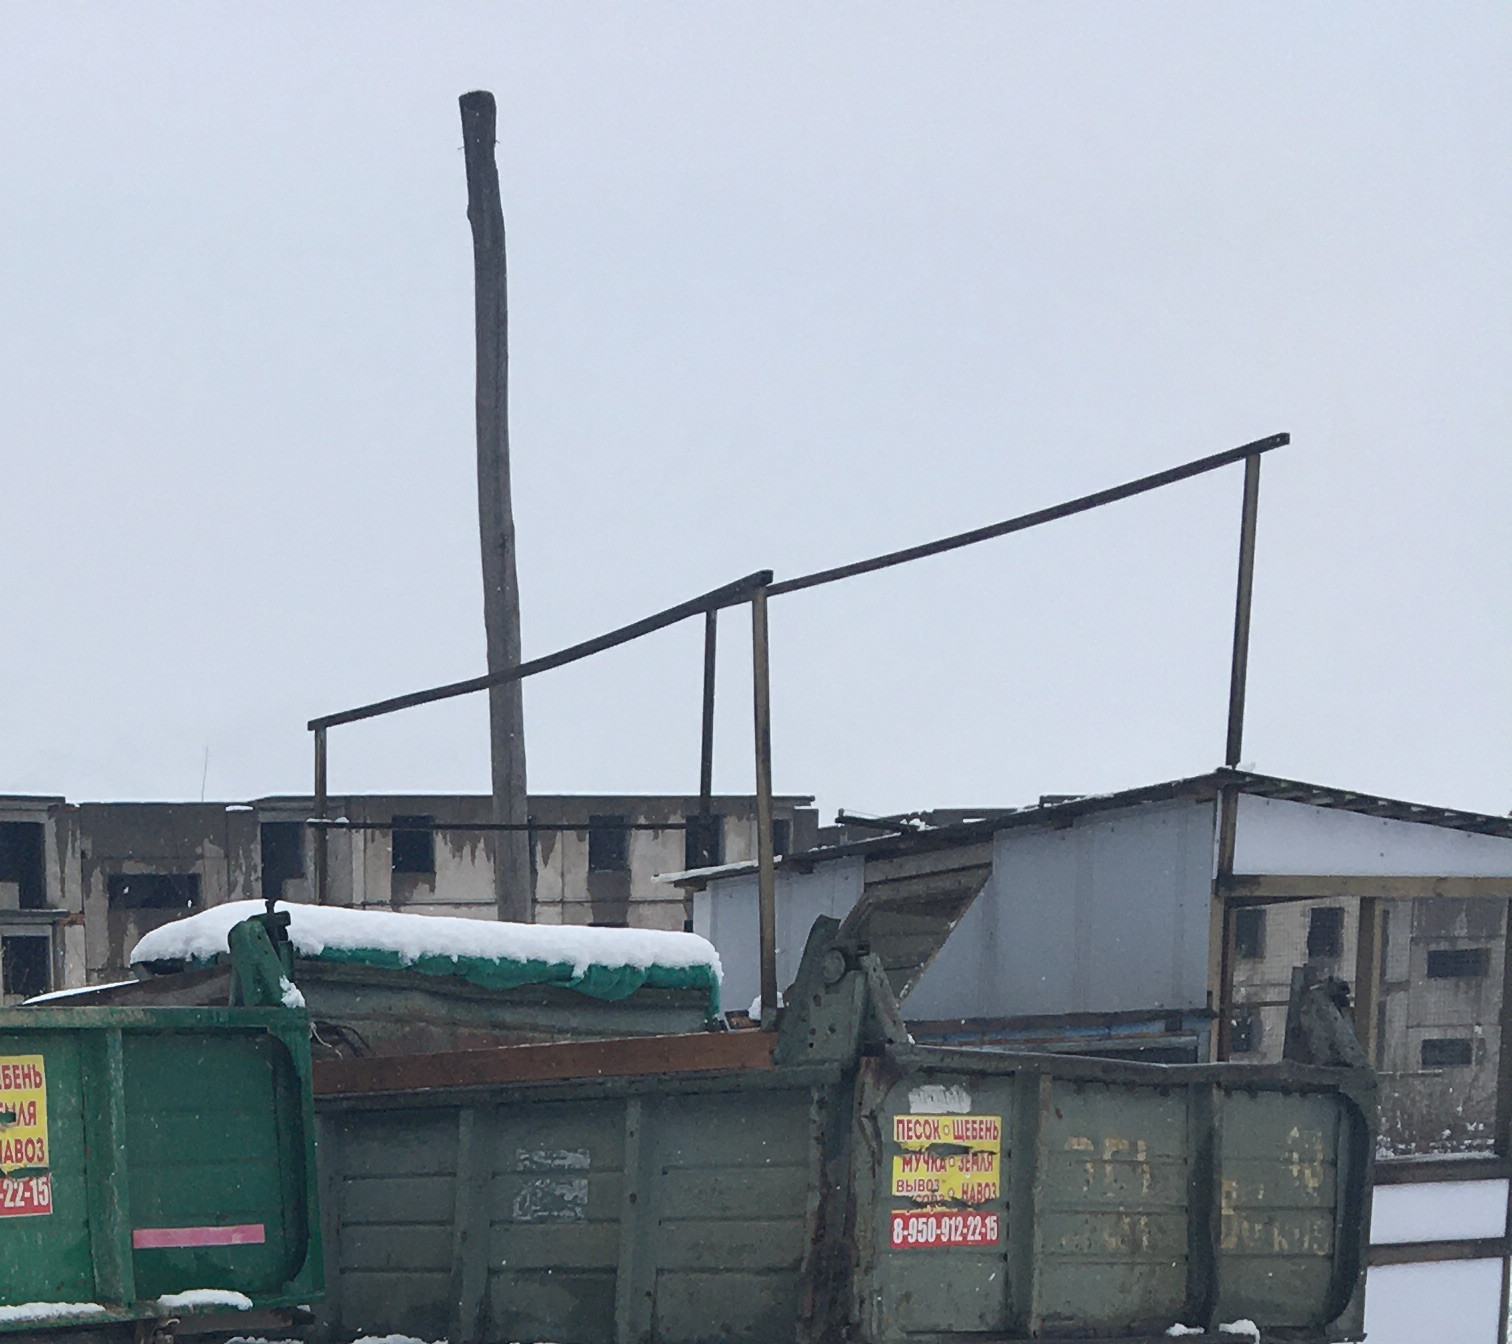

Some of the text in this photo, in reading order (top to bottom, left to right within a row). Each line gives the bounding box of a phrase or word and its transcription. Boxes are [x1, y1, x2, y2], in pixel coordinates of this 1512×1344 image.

[896, 1119, 999, 1142] ПЕСОК ЩЕБЕНЬ
[896, 1178, 940, 1193] ВЫВОЗ
[893, 1215, 998, 1244] 8-950-912-22-15
